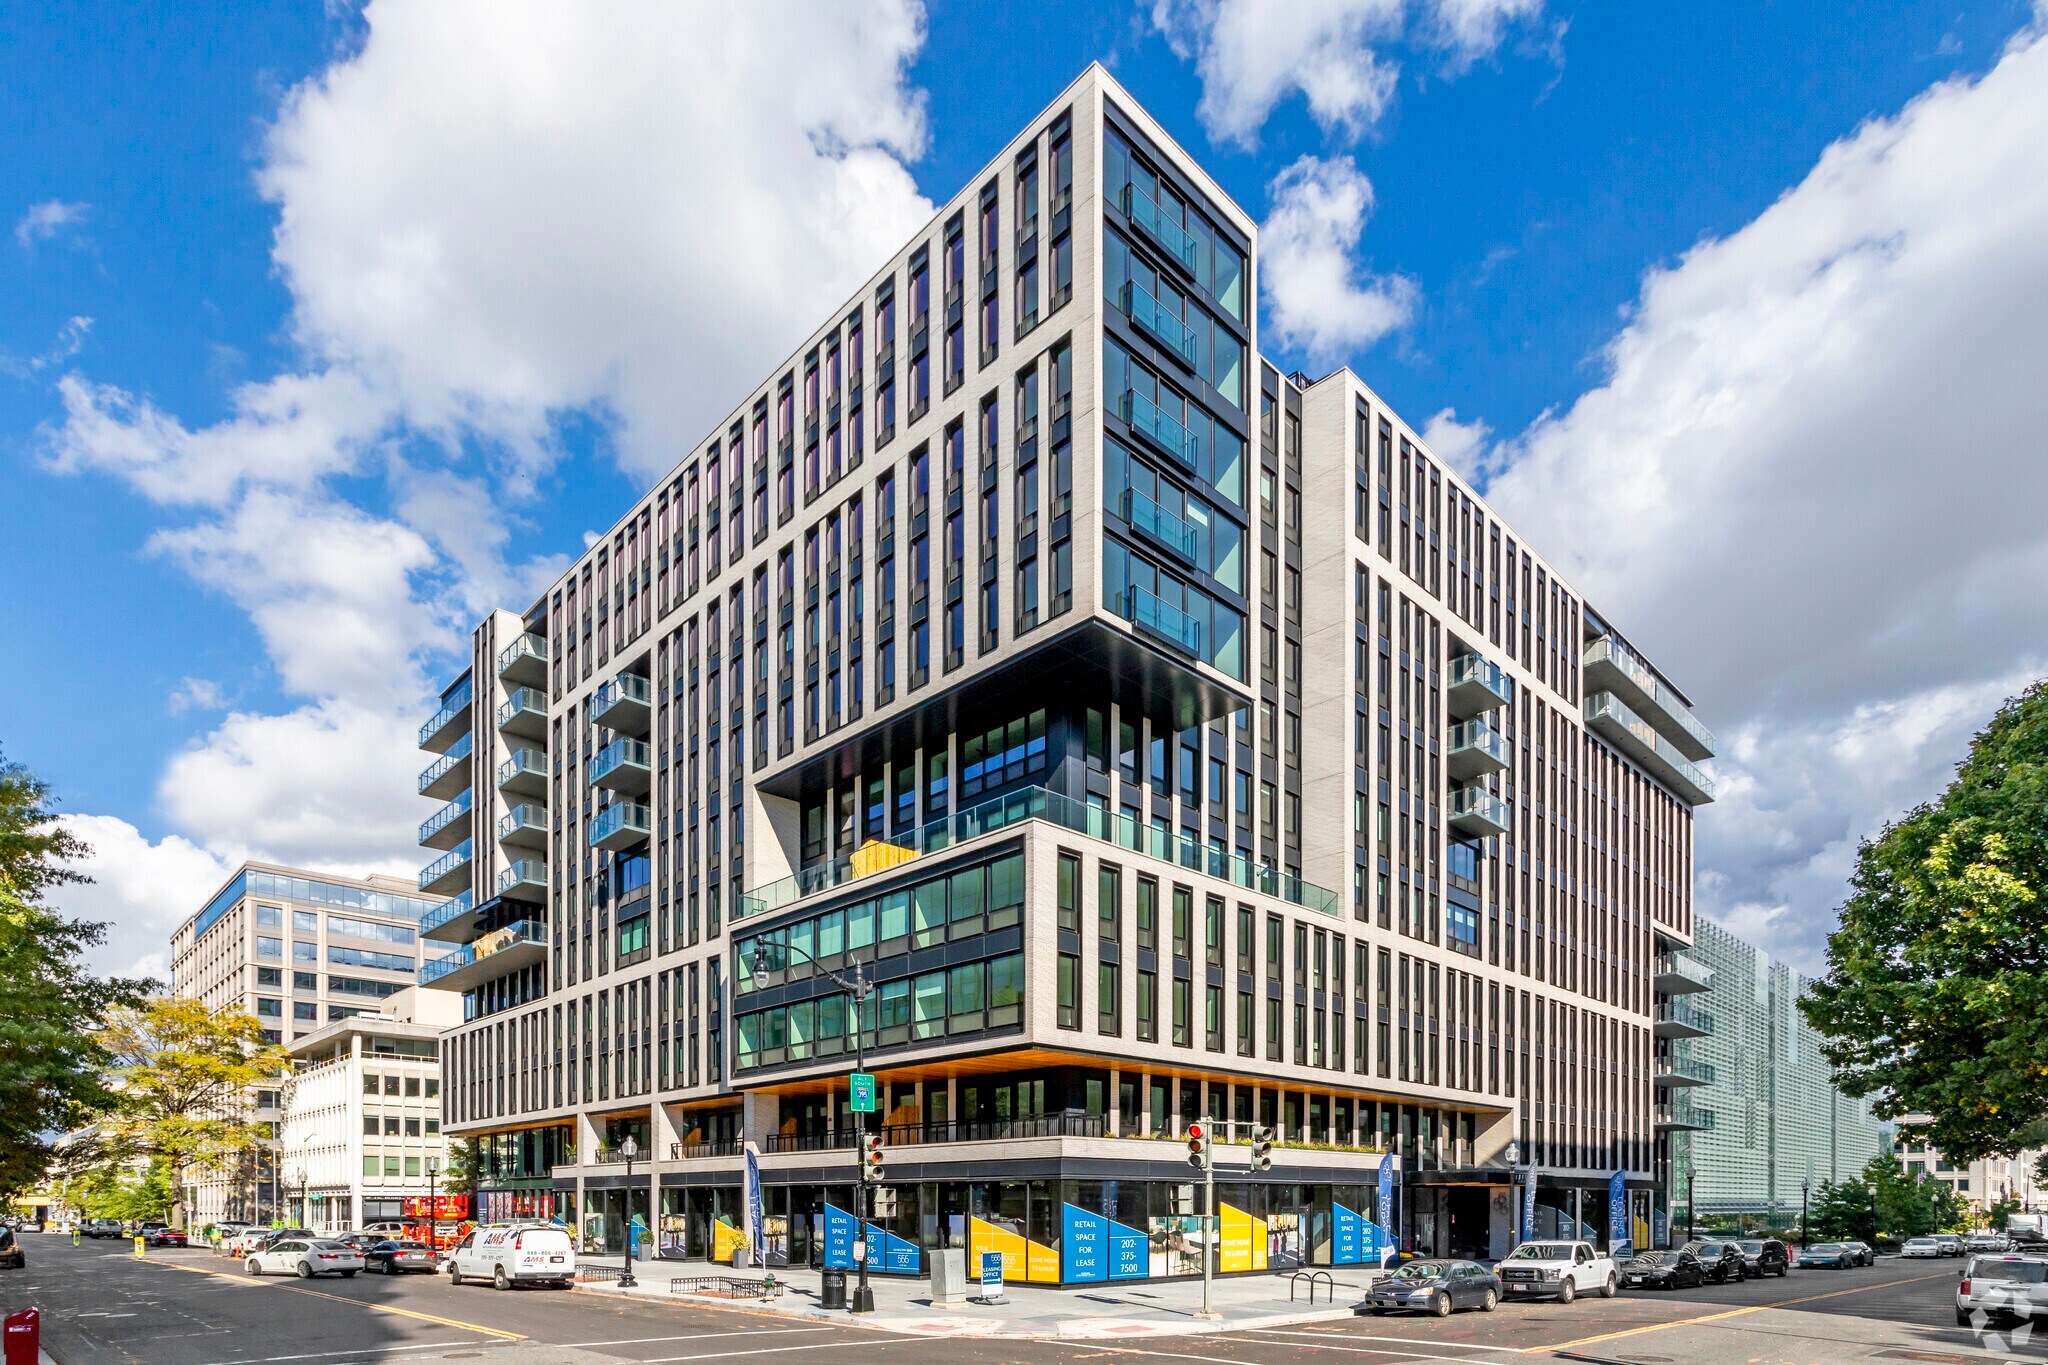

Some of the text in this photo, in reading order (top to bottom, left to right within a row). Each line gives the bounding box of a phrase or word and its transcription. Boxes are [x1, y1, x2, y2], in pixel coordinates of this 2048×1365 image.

[1526, 1194, 1534, 1231] OFFICE
[1122, 1240, 1136, 1248] 202-
[1121, 1252, 1136, 1260] 375-
[866, 1256, 878, 1265] 500
[1121, 1264, 1137, 1272] 7500
